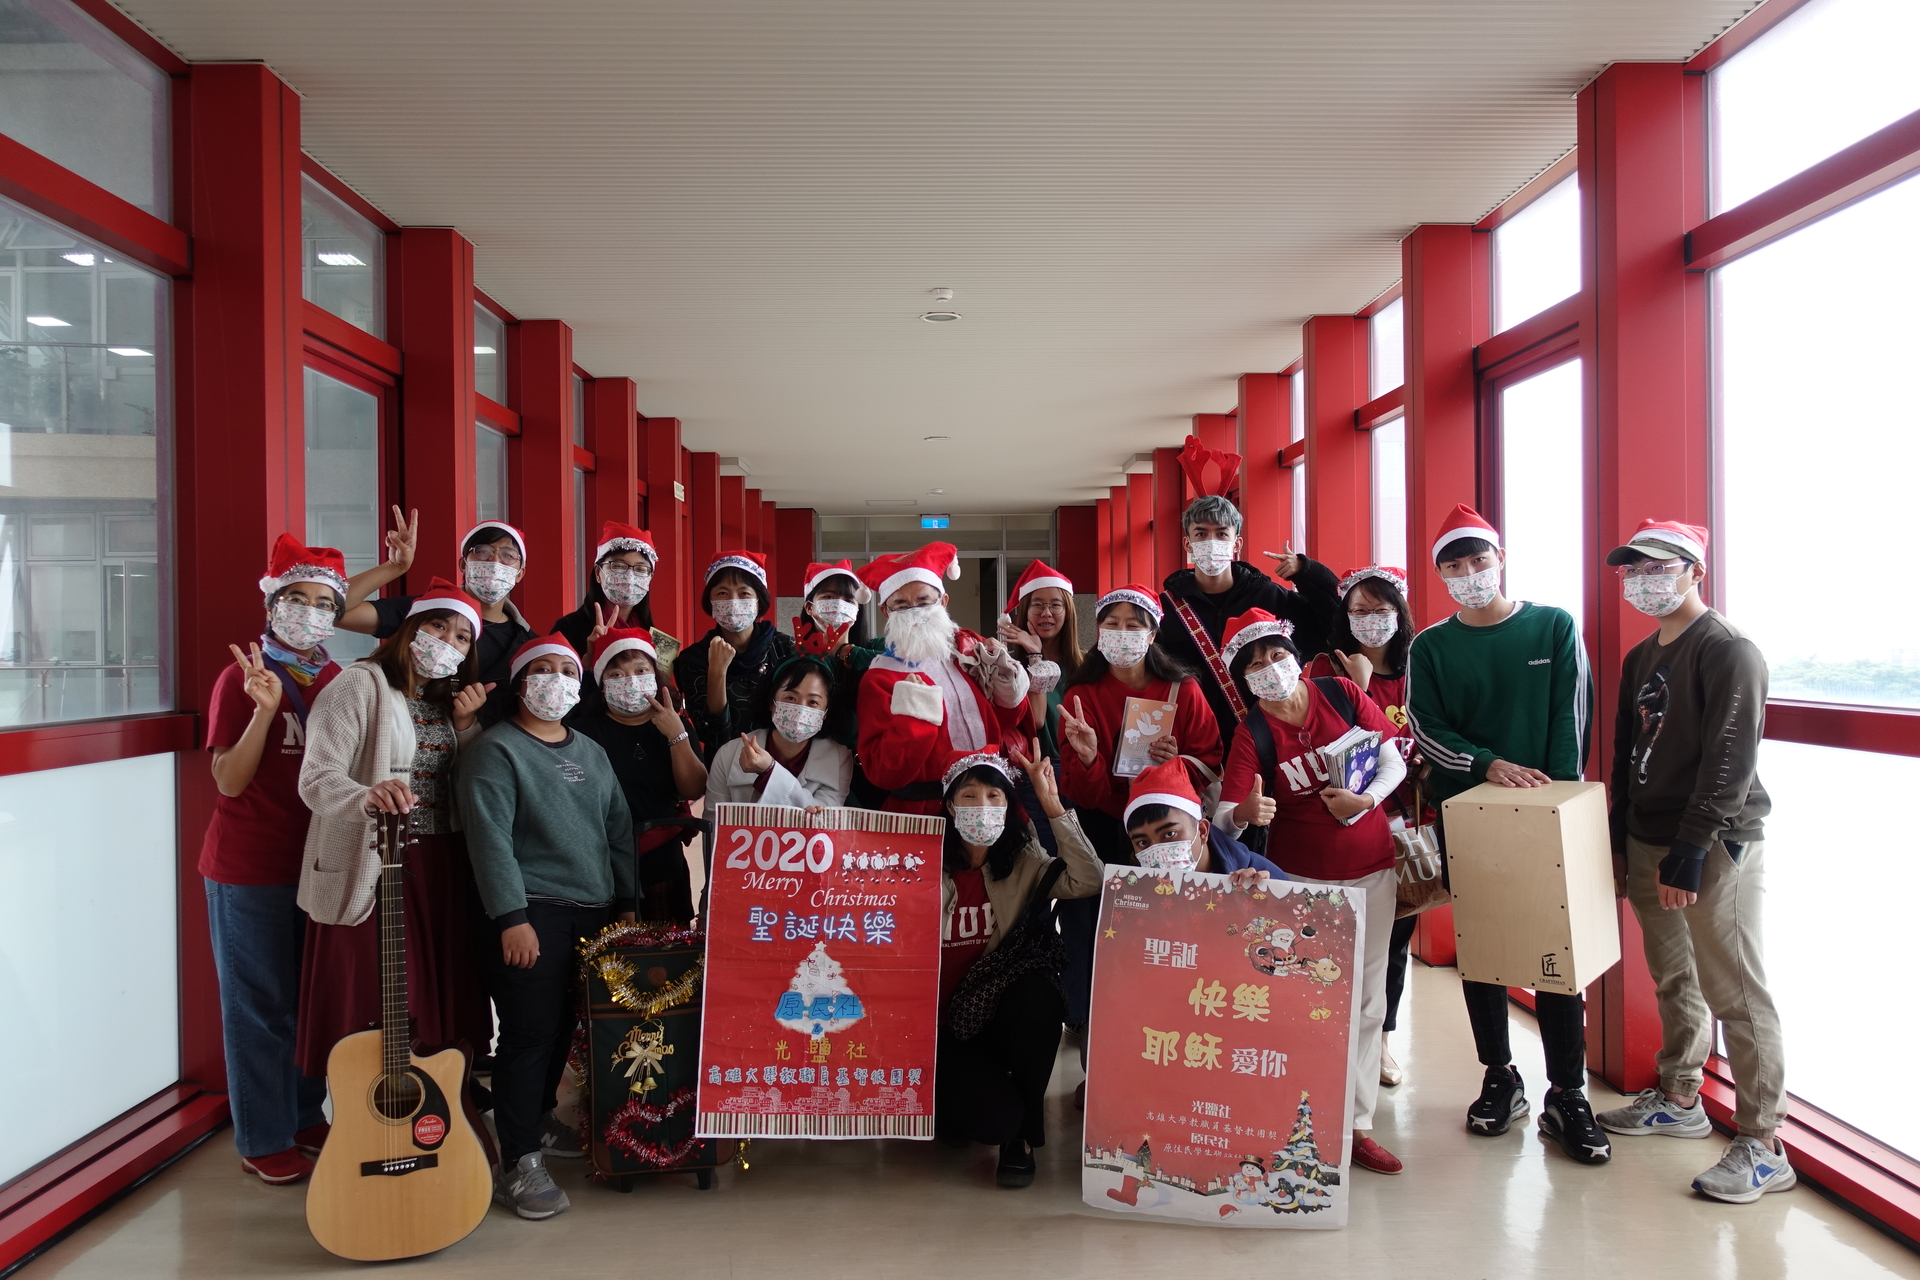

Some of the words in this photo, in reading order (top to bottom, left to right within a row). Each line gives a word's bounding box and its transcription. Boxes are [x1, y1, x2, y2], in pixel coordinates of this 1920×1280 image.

[1528, 658, 1551, 666] adidas
[726, 829, 834, 873] 2020
[742, 871, 803, 898] Merry
[810, 888, 897, 909] Christmas
[1114, 898, 1150, 909] Christmas
[747, 905, 896, 945] 聖誕快樂
[1143, 937, 1198, 970] 聖誕
[1541, 953, 1562, 979] 匠
[775, 993, 862, 1018] 原民社
[1188, 977, 1271, 1023] 快樂
[774, 1037, 868, 1064] 光鹽社
[1230, 1047, 1288, 1079] 愛你
[1191, 1100, 1232, 1120] 光鹽社
[1190, 1132, 1231, 1150] 原民社
